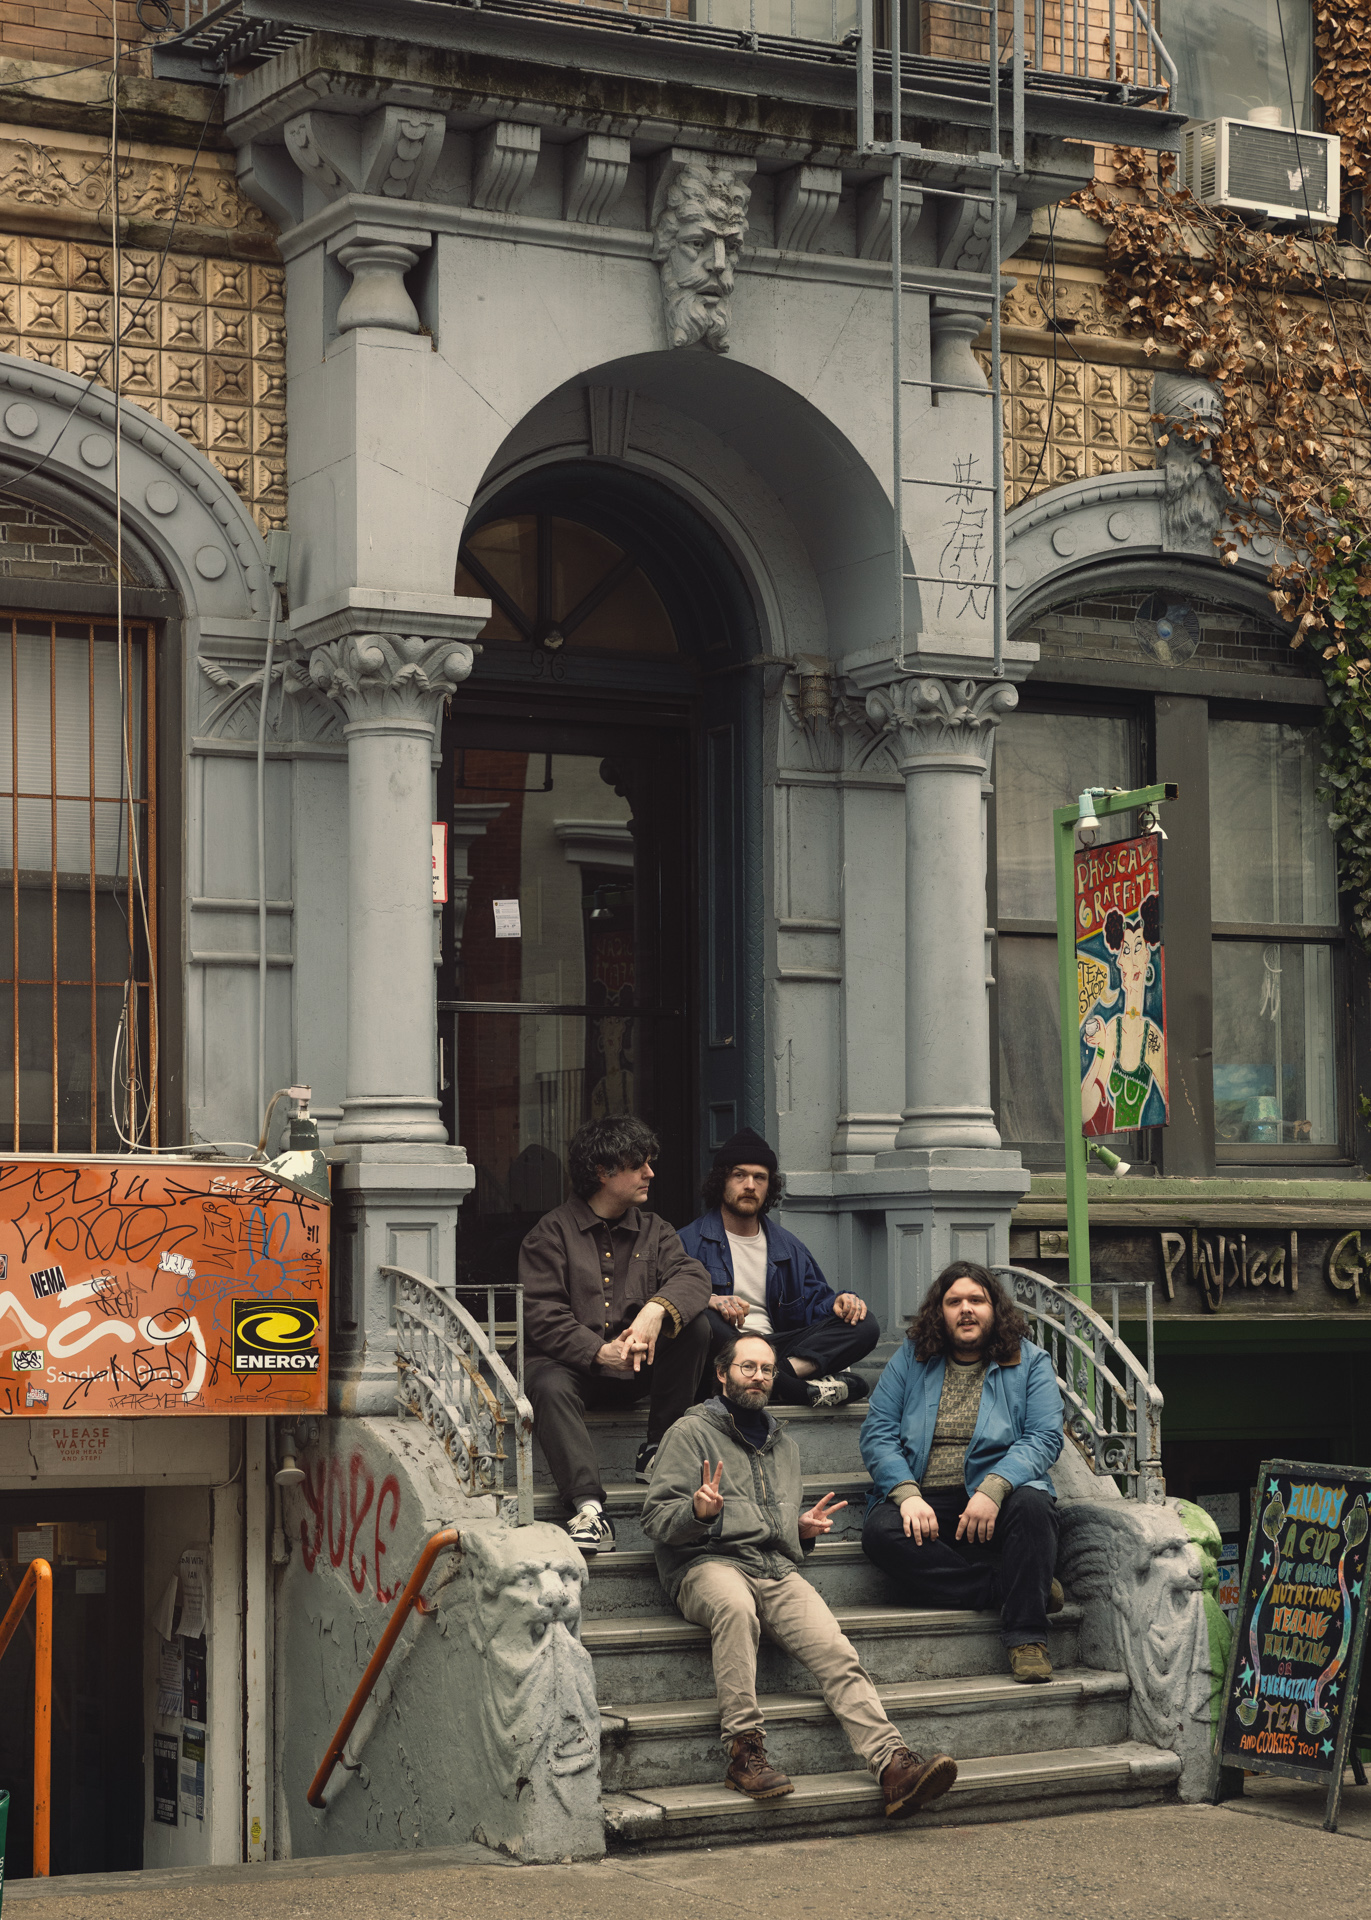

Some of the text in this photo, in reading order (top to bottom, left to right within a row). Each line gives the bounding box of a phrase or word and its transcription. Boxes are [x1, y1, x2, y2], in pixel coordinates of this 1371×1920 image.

[531, 648, 567, 682] 96
[1078, 961, 1107, 987] TEA
[1079, 980, 1104, 1013] SHOP
[31, 1267, 66, 1297] NEMA
[1160, 1228, 1299, 1312] Physical
[47, 1365, 181, 1386] Sandwich Shop
[236, 1355, 319, 1369] ENERGY
[53, 1428, 110, 1438] PLEASE
[56, 1439, 106, 1448] WATCH
[1286, 1483, 1347, 1528] ENJOY
[1280, 1523, 1340, 1565] A CUP
[1279, 1561, 1337, 1587] OF ORGANIC
[1269, 1582, 1342, 1612] NUTRITIOUS
[1271, 1606, 1332, 1640] HEALING
[1262, 1634, 1331, 1667] RELAXING
[1278, 1662, 1292, 1675] OR
[1260, 1674, 1317, 1701] ENERGIZING
[1263, 1700, 1299, 1733] TEA
[1240, 1731, 1319, 1758] AND COOKIES TOO!
